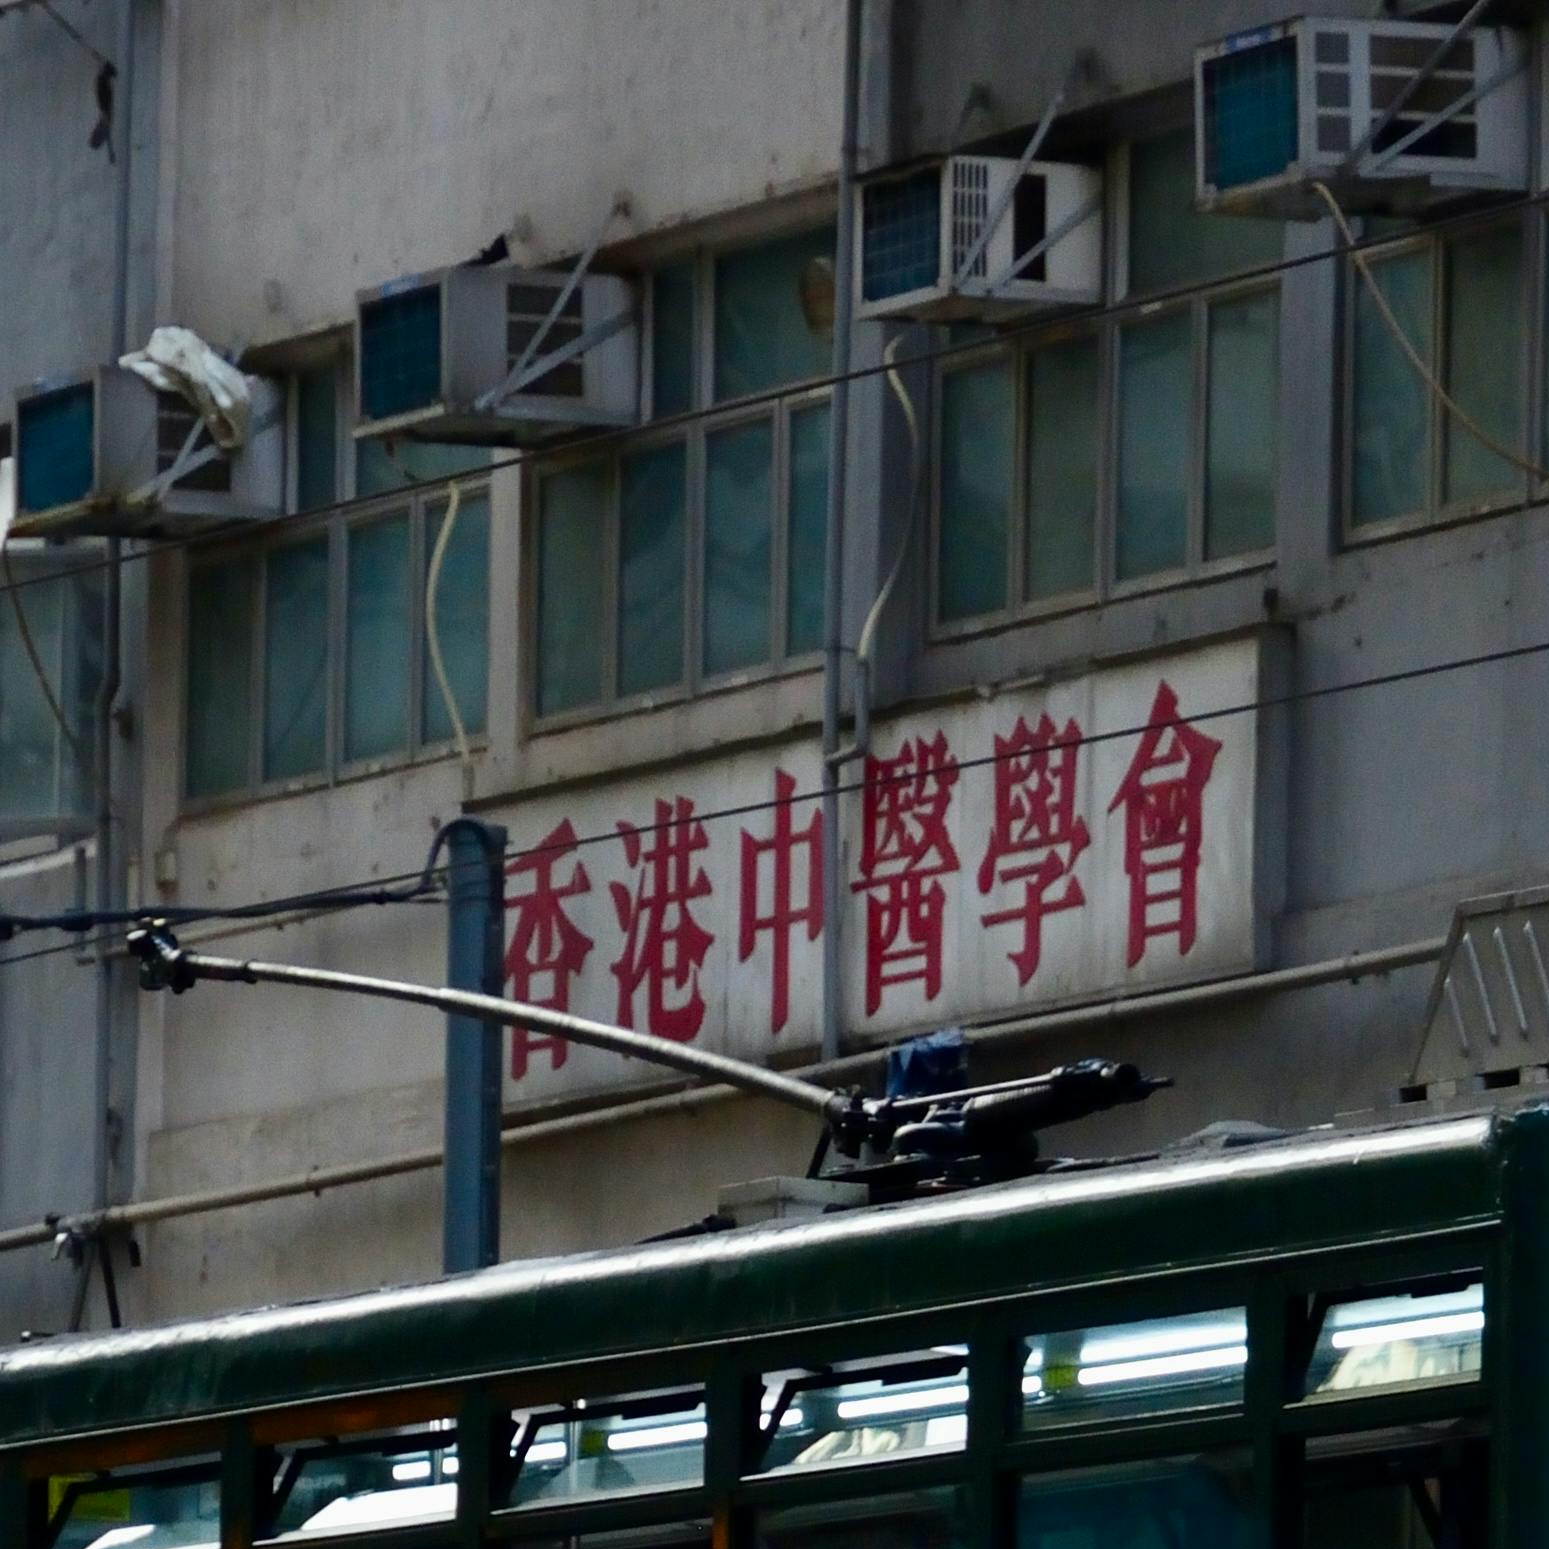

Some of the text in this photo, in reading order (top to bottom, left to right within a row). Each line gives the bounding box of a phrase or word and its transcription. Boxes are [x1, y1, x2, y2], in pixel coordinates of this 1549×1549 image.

[503, 680, 1222, 1081] 香港中醫學會
